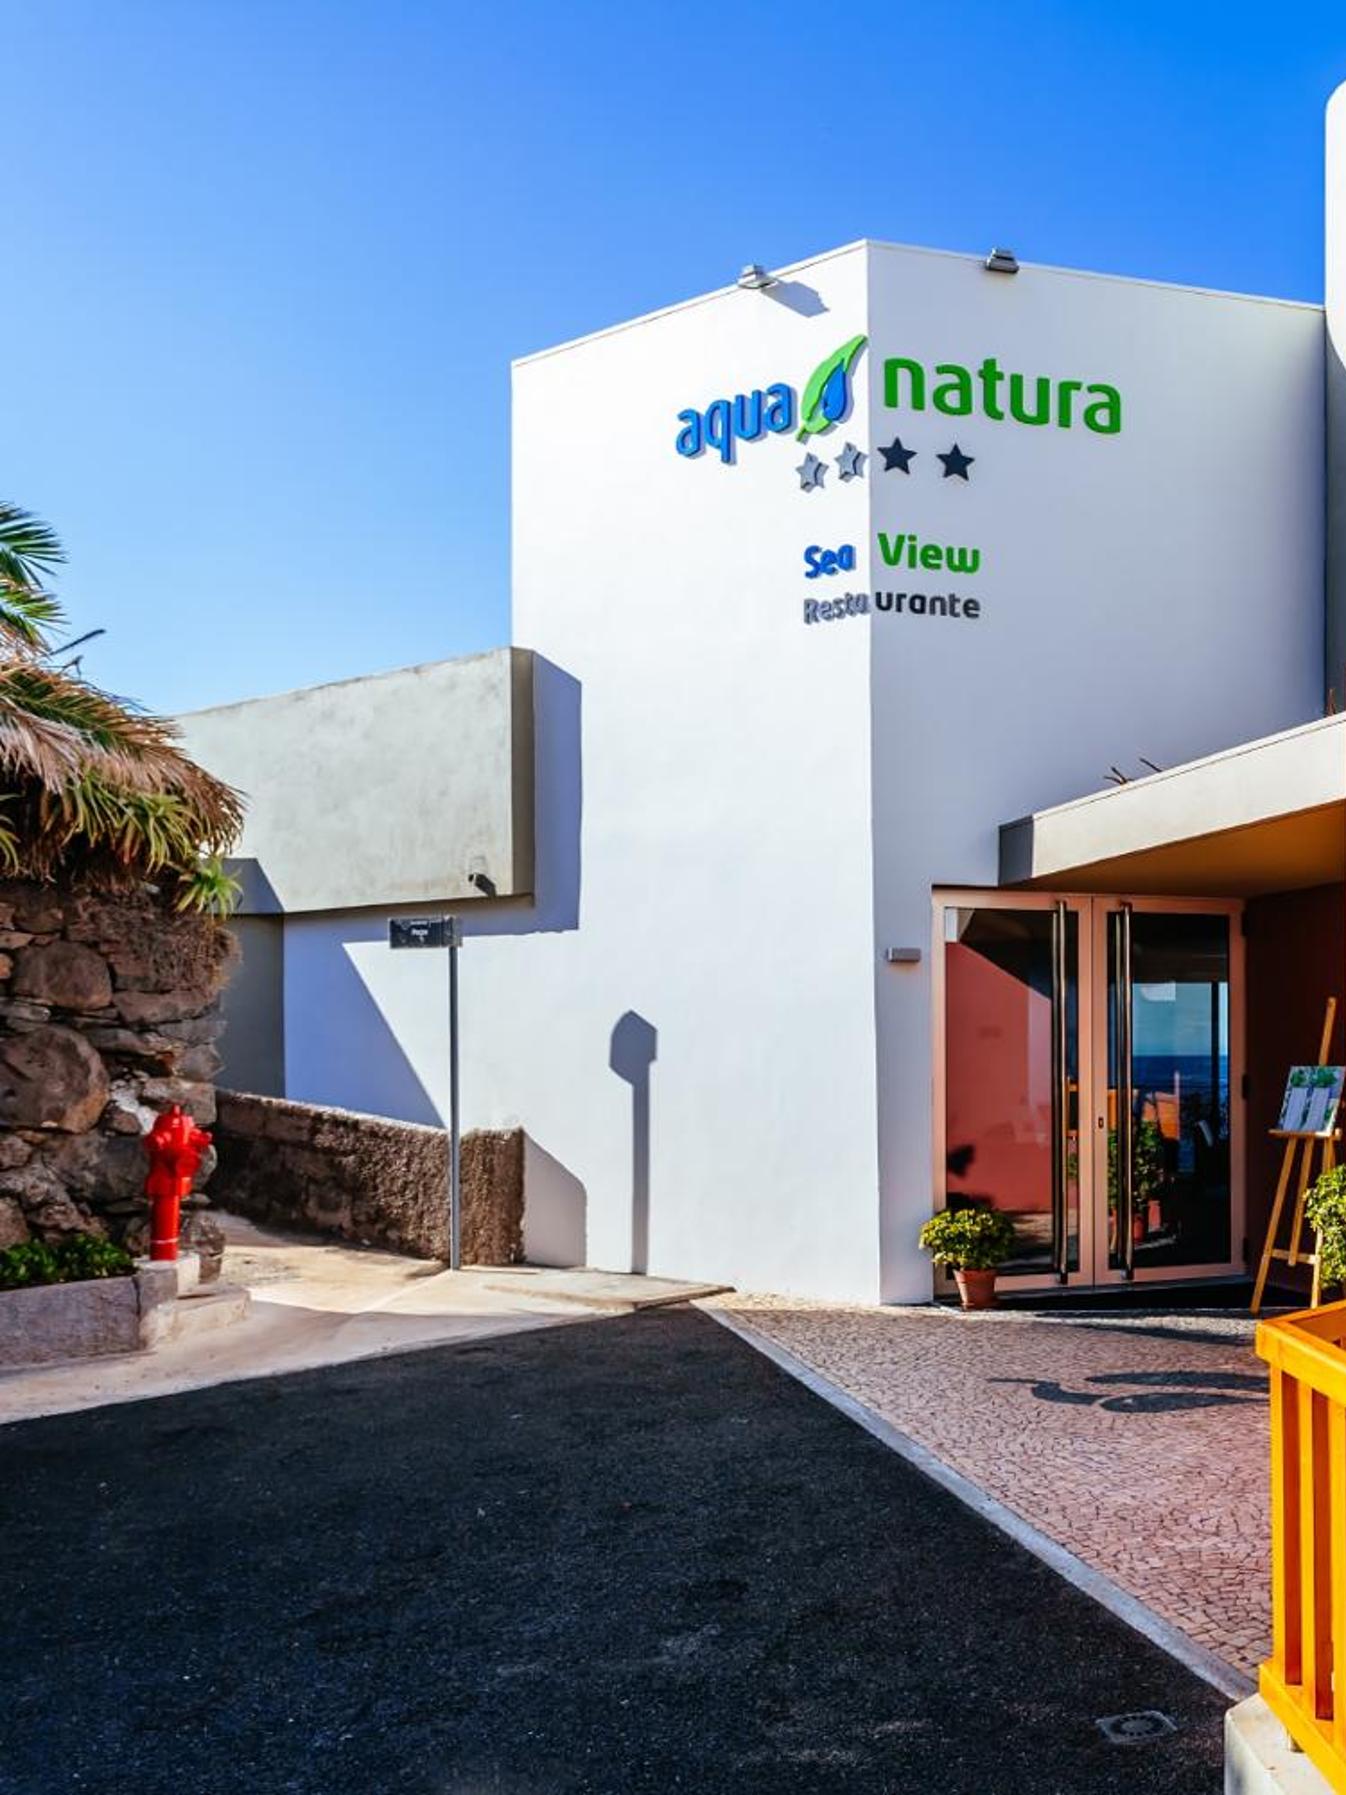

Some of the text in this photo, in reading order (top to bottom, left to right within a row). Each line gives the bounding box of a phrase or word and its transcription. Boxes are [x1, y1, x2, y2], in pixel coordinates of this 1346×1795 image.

[675, 357, 1123, 464] aqua natura
[803, 532, 982, 579] Sea View
[803, 590, 982, 625] Restaurante
